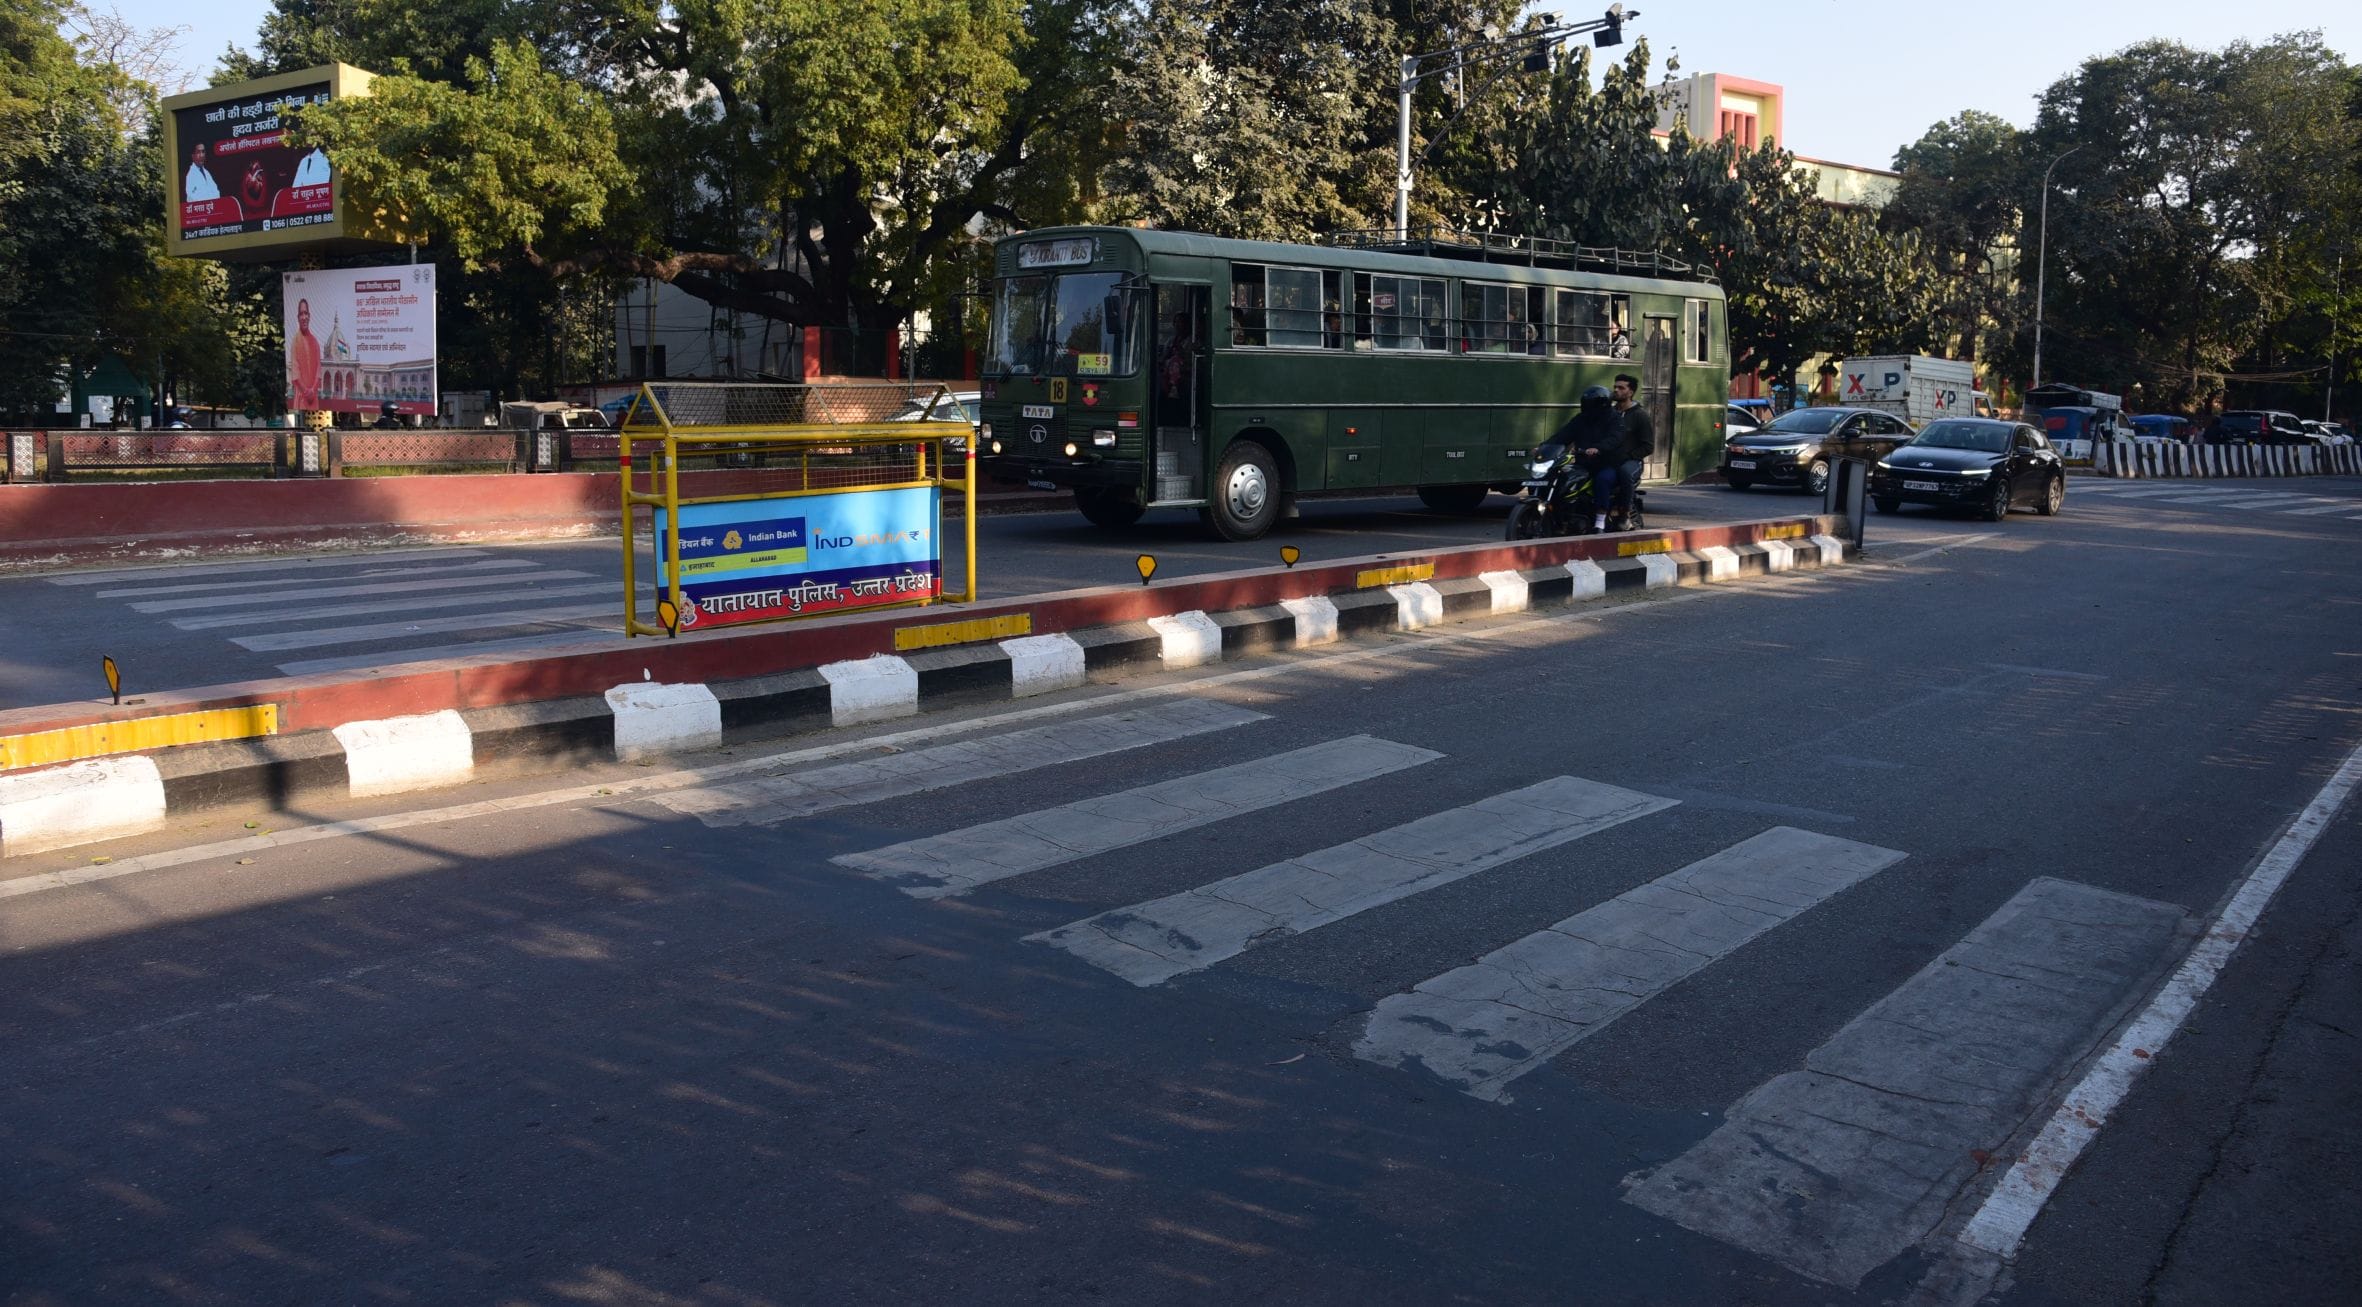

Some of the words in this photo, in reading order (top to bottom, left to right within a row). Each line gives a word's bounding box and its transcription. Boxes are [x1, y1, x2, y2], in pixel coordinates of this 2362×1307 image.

[205, 108, 226, 123] छाती
[227, 106, 240, 119] की
[232, 123, 253, 137] हृदय
[254, 116, 279, 132] सर्जरी
[271, 219, 286, 228] 1066
[289, 217, 304, 227] 0522
[305, 216, 313, 225] 67
[1071, 244, 1088, 261] BUS
[1095, 356, 1109, 367] 59
[1053, 380, 1064, 400] 18
[1024, 407, 1051, 417] TATA
[748, 532, 775, 542] Indian
[776, 529, 798, 540] Bank
[701, 588, 786, 614] यातायात
[788, 579, 844, 612] पुलिस,
[851, 577, 893, 597] उत्तर
[894, 568, 933, 593] प्रदेश
